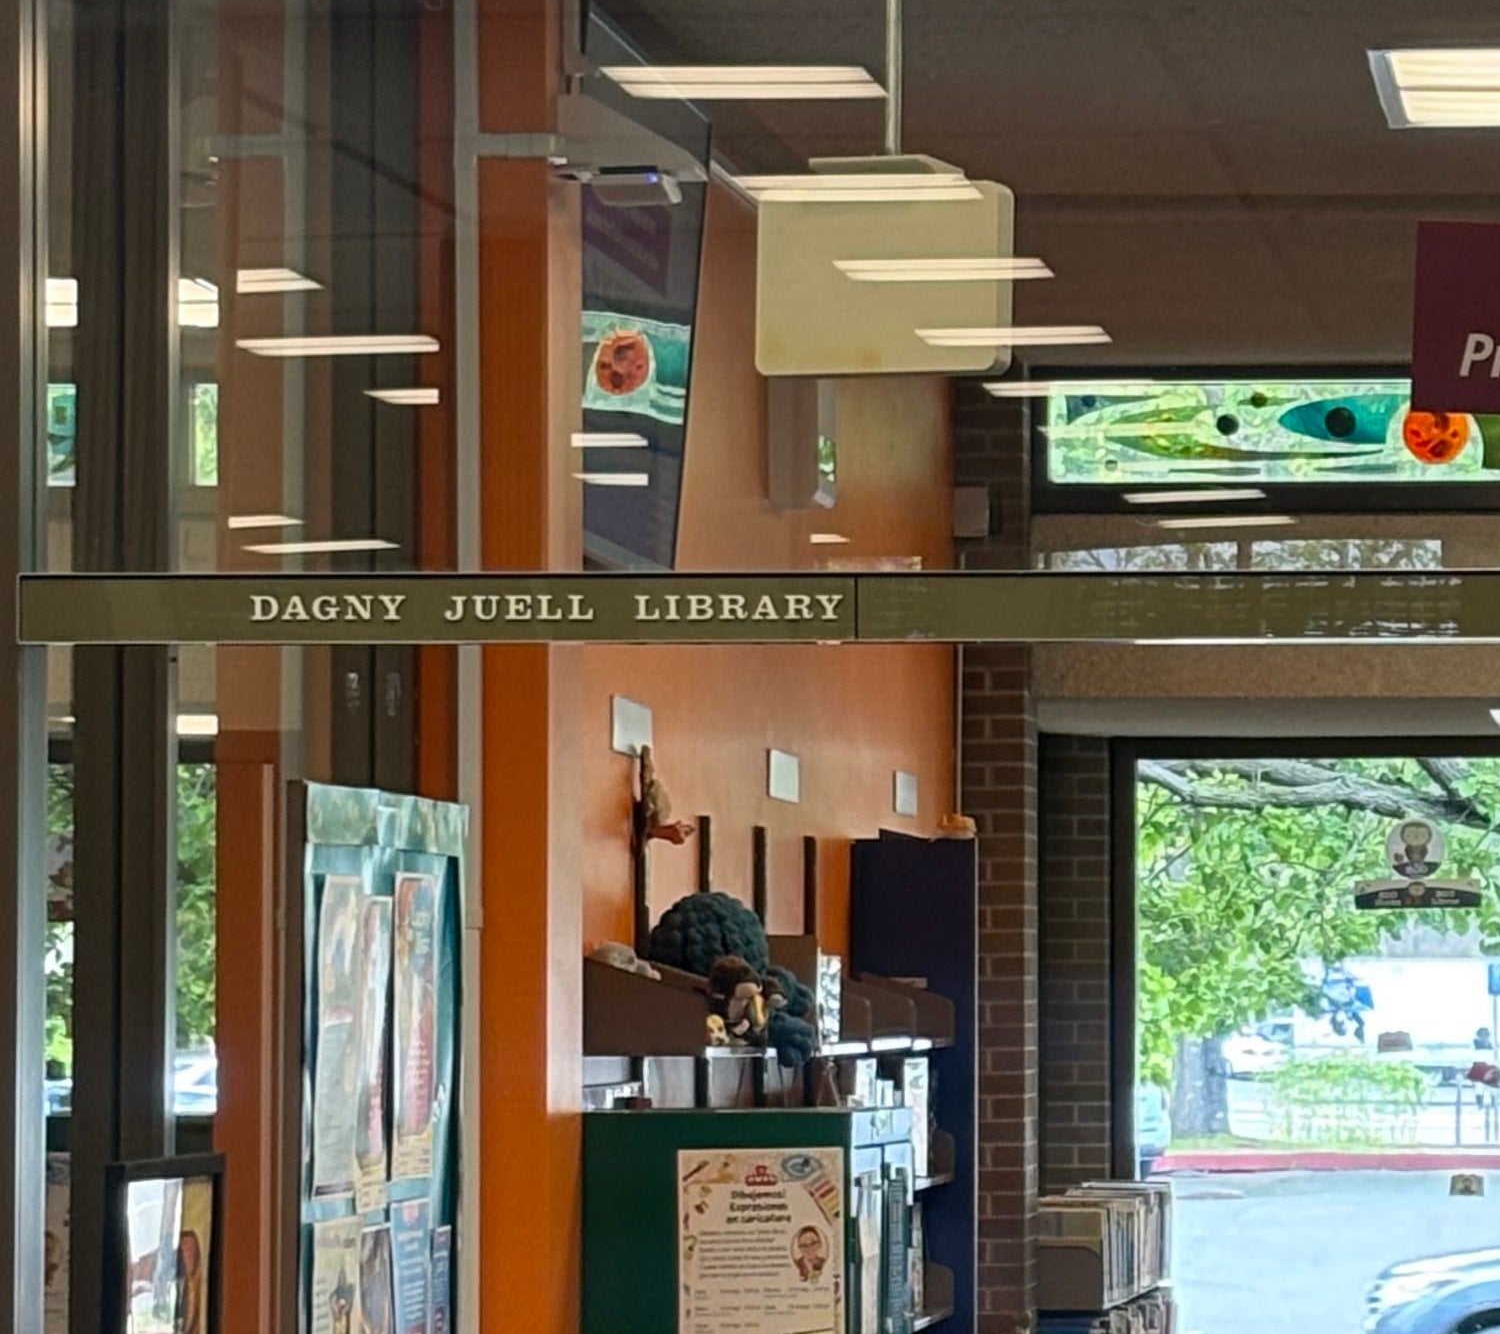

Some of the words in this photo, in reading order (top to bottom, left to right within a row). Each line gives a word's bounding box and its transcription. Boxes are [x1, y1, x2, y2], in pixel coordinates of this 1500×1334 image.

[249, 594, 407, 622] DAGNY
[444, 594, 595, 621] JUELL
[634, 593, 843, 621] LIBRARY
